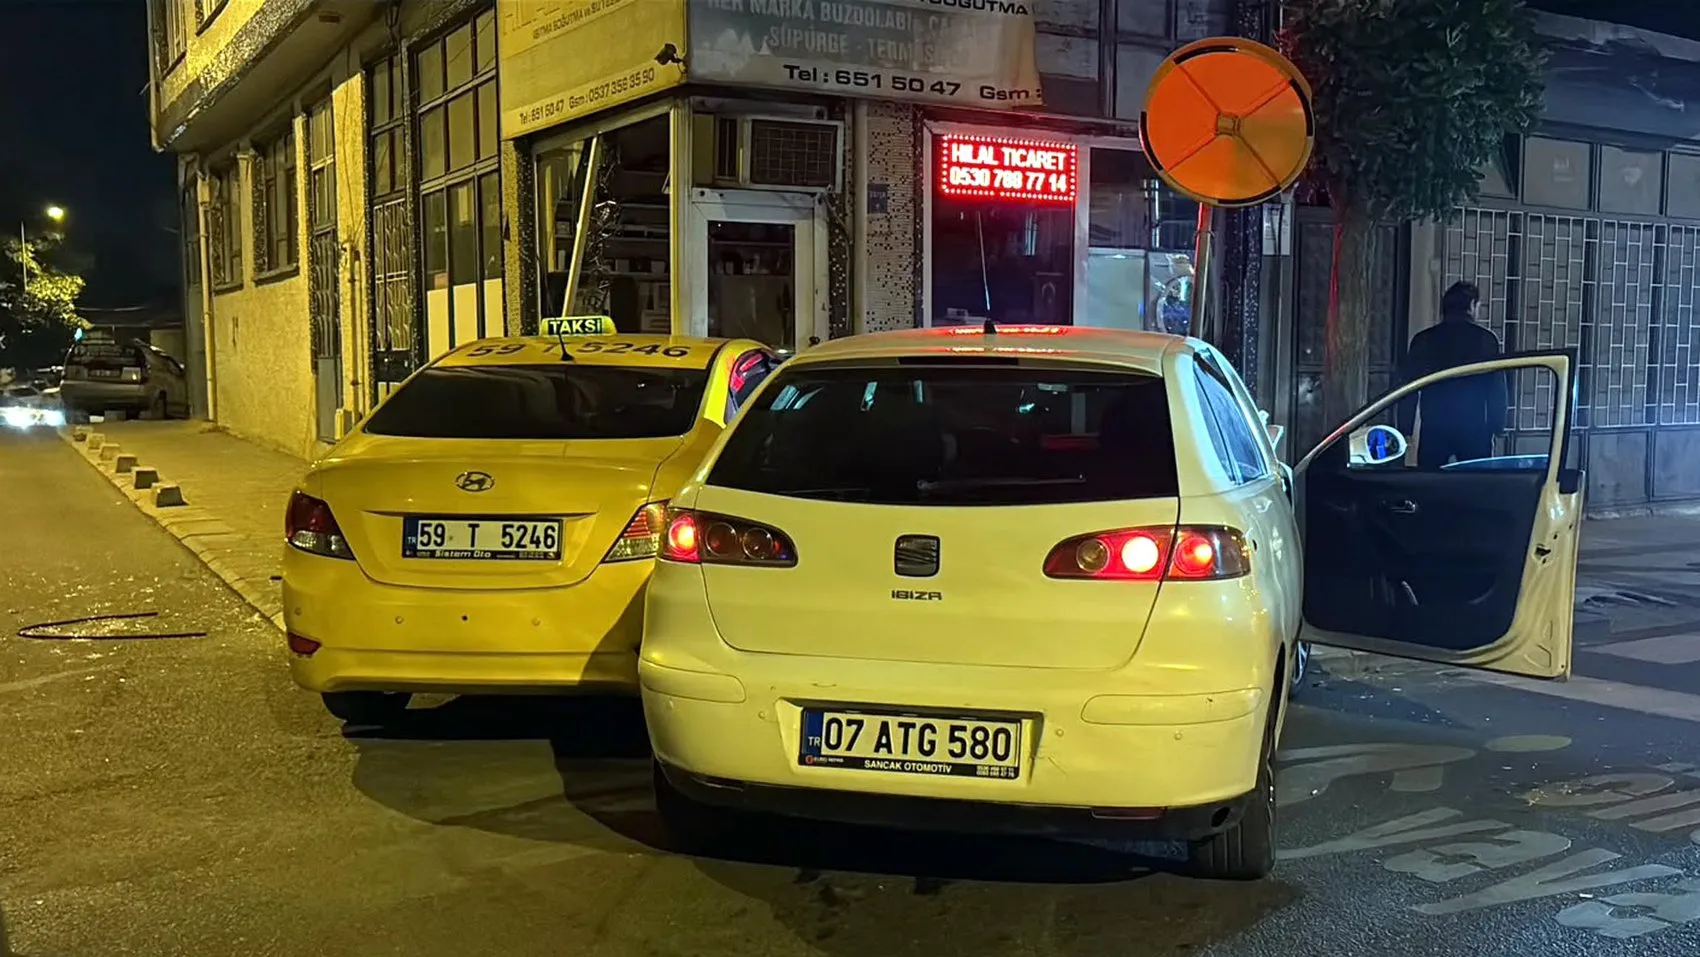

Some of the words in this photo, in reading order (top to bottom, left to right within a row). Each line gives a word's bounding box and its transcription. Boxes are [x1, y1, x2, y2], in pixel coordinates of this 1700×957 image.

[835, 70, 882, 89] 651
[892, 77, 924, 93] 50
[930, 81, 961, 96] 47
[949, 166, 990, 187] 0530
[1026, 171, 1045, 191] 77
[1049, 173, 1067, 192] 14
[466, 343, 527, 357] 59
[575, 342, 690, 357] 5246
[420, 522, 446, 548] 59
[467, 523, 480, 548] T
[501, 524, 556, 549] 5246
[890, 590, 943, 600] IBIZA
[808, 736, 821, 747] TR
[824, 717, 865, 751] 07
[873, 720, 938, 757] ATG
[948, 724, 1013, 762] 580
[864, 759, 902, 771] SANCAK
